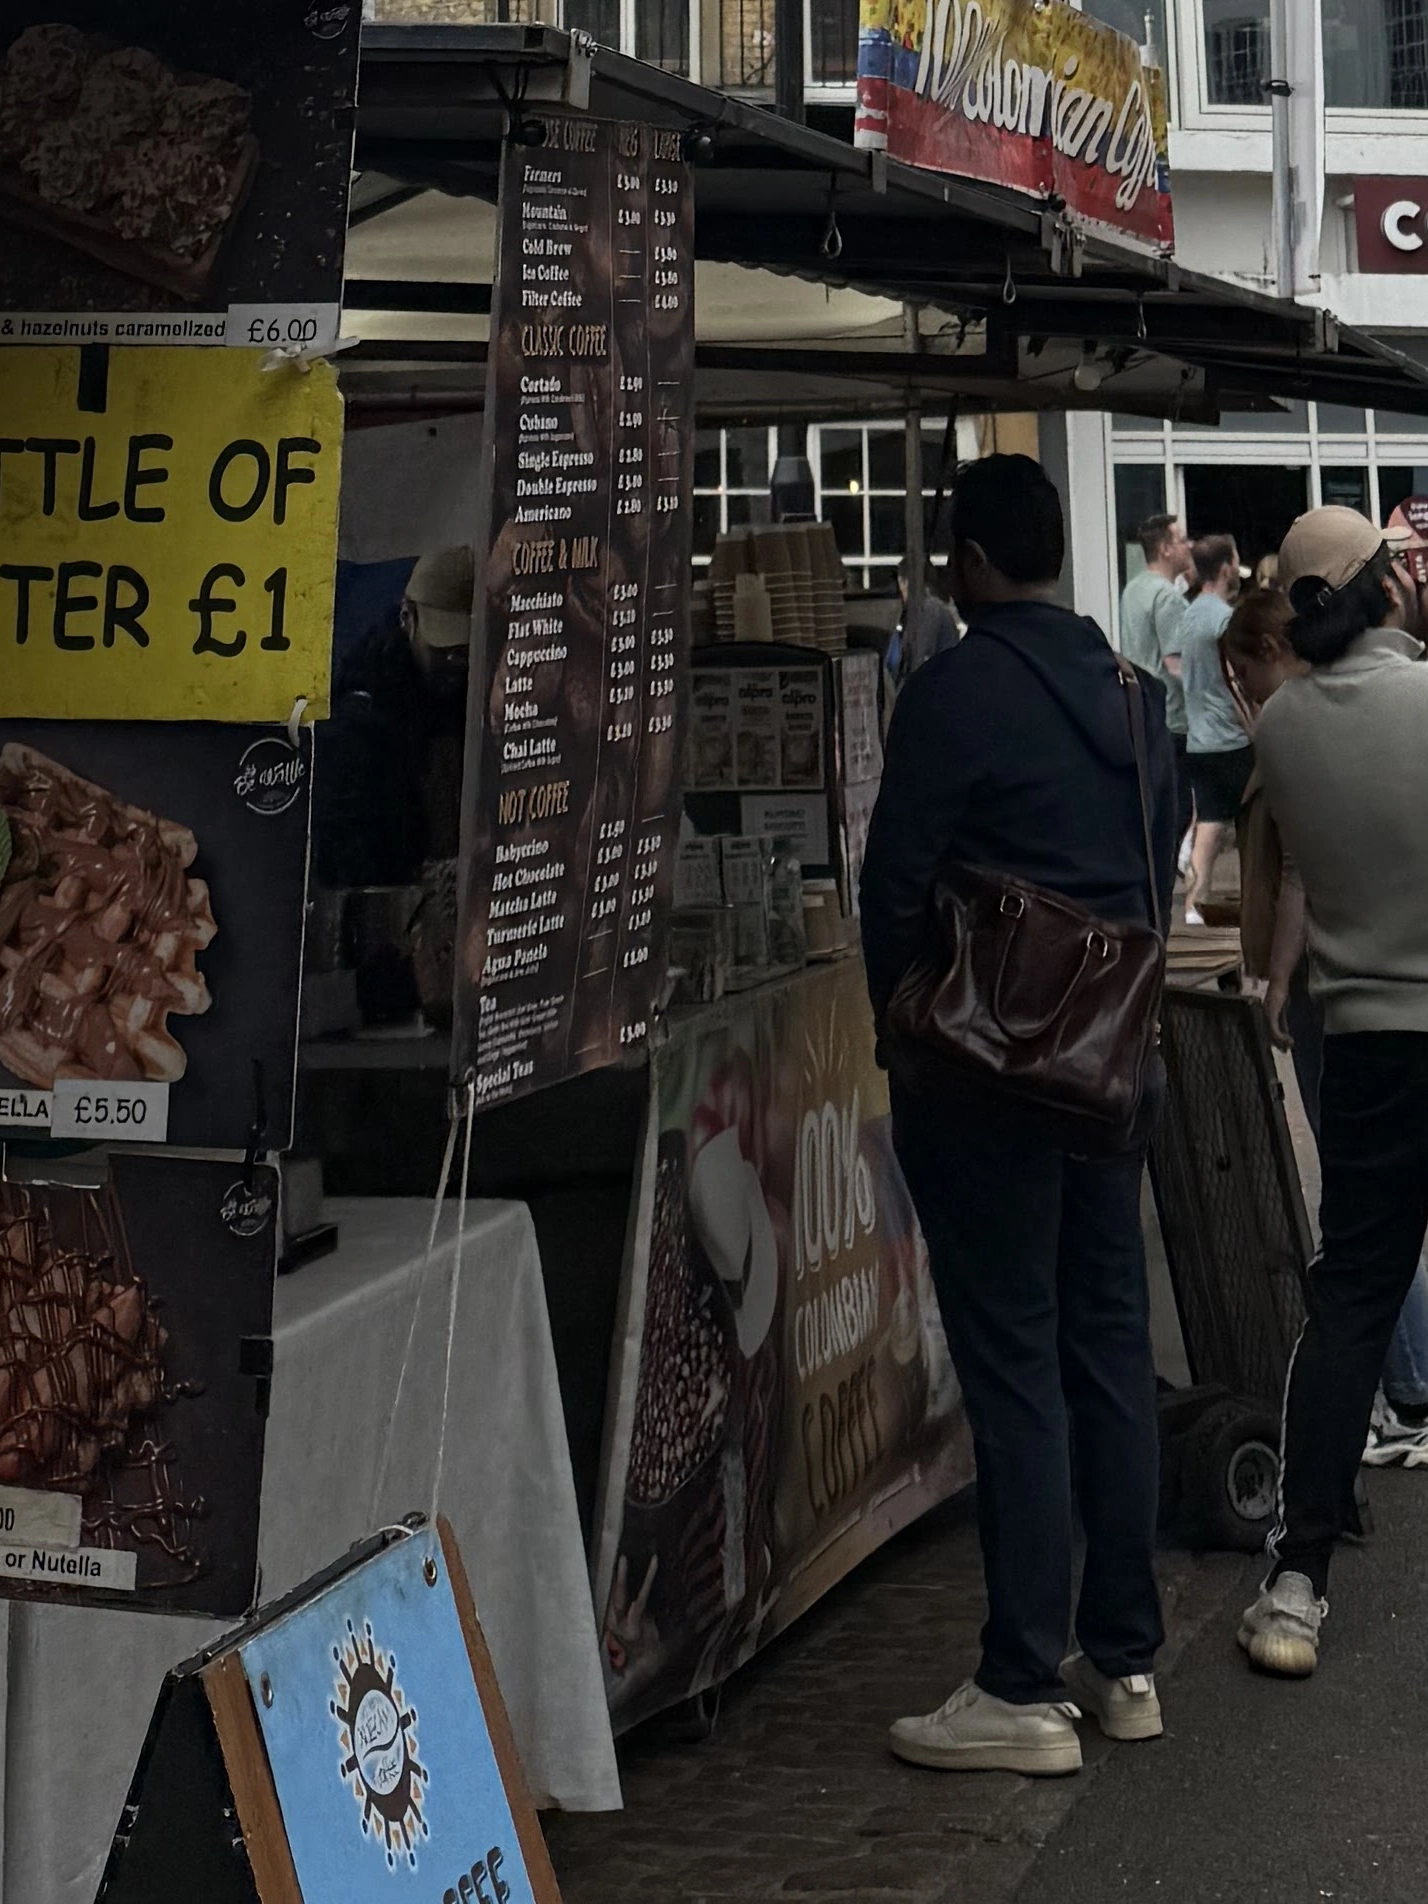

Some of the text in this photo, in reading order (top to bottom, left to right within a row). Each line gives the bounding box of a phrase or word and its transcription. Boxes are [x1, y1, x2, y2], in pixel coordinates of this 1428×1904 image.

[522, 202, 568, 221] Mountain
[522, 238, 545, 255] Cold
[546, 239, 573, 256] Brew
[538, 264, 570, 282] Coffee
[522, 289, 583, 308] Filter Coffee
[2, 319, 15, 336] &
[21, 317, 109, 337] hazelnuts
[115, 320, 226, 338] caramelized
[247, 319, 318, 343] £6.00
[522, 322, 607, 357] CLASSIC COFFEE
[519, 375, 562, 393] Cortado
[518, 413, 559, 432] Cubano
[517, 451, 551, 474] Single
[551, 449, 595, 472] Espresso
[209, 437, 321, 526] OF
[516, 476, 599, 498] Double Espresso
[514, 504, 573, 524] Americano
[512, 539, 556, 576] COFFEE
[571, 535, 600, 569] MILK
[188, 562, 291, 658] £1
[509, 590, 564, 614] Macchiato
[507, 620, 531, 641] Flat
[532, 617, 564, 637] White
[506, 643, 569, 670] Cappuccino
[504, 675, 534, 695] Latte
[503, 700, 539, 722] Mocha
[503, 741, 528, 761] Chai
[529, 736, 557, 758] Latte
[498, 779, 571, 826] NOT COFFEE
[494, 838, 550, 865] Babyccino
[492, 871, 513, 893] Hot
[514, 862, 566, 888] Chocolate
[488, 896, 529, 921] Matcha
[530, 889, 558, 911] Latte
[486, 923, 538, 948] Turmeric
[538, 914, 566, 936] Latte
[481, 954, 513, 977] Agua
[479, 994, 498, 1015] Tea
[475, 1063, 510, 1095] Special
[512, 1059, 535, 1081] Teas
[74, 1096, 147, 1125] £5.50
[793, 1085, 876, 1280] 100%
[794, 1258, 880, 1384] COLOMBIAN
[798, 1352, 883, 1516] COFFEE
[5, 1553, 25, 1570] or
[32, 1548, 102, 1578] Nutella
